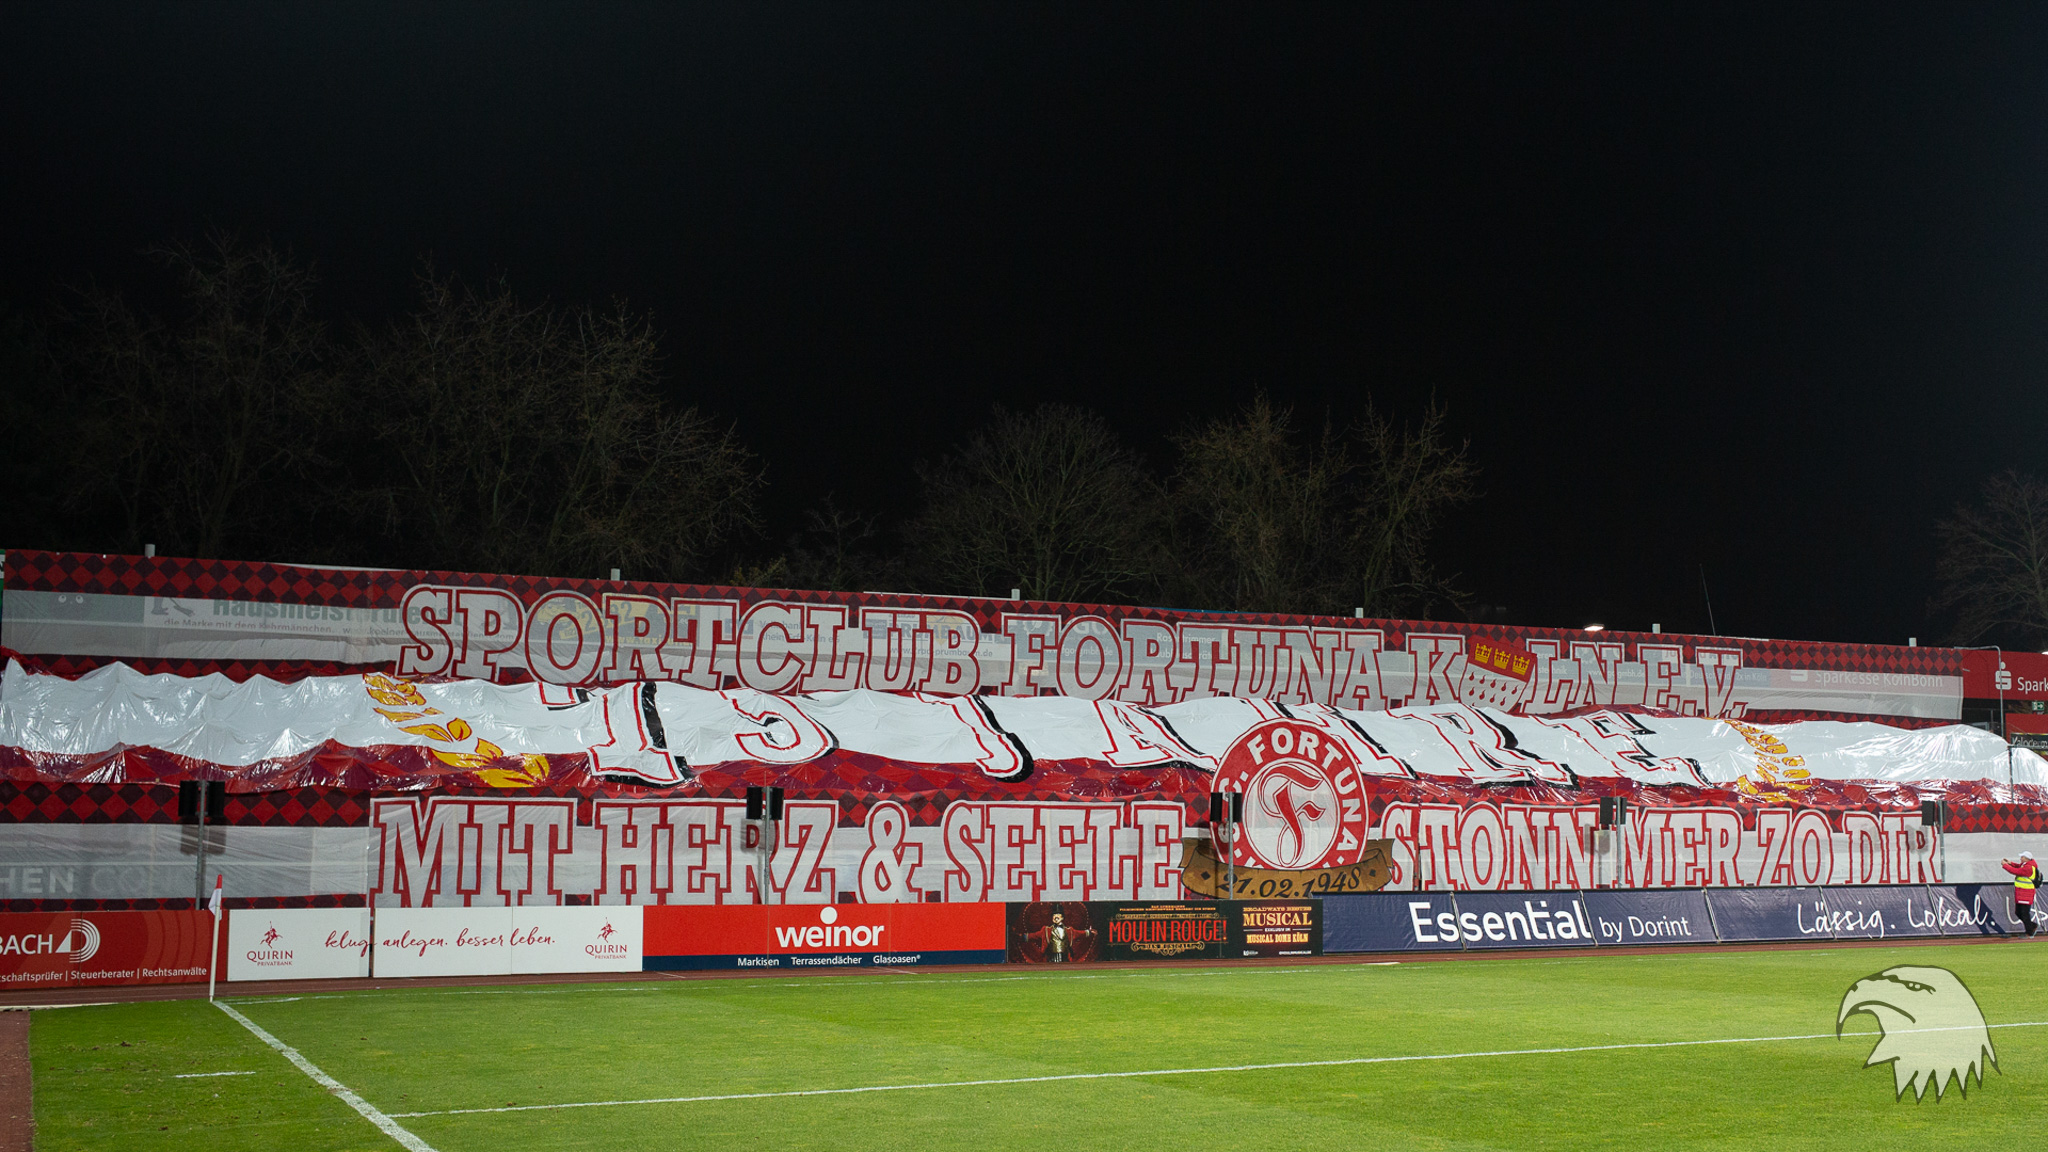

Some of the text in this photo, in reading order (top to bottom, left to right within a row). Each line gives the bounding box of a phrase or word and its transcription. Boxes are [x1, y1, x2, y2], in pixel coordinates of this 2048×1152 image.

[182, 619, 213, 627] Marke
[215, 621, 232, 629] mit
[234, 621, 257, 629] dem
[397, 584, 981, 694] SPORTCLUB
[1001, 612, 1384, 711] FORTUNA
[1814, 671, 1880, 686] Sparkasse
[1246, 727, 1362, 851] FORTUNA
[370, 796, 1943, 908] MIT HERZ & SEELE STONN MER ZO DIR
[1216, 866, 1362, 899] 21.02.1948
[775, 906, 885, 948] weinor
[1243, 912, 1312, 927] MUSICAL
[1408, 899, 1692, 943] Essential by Dorint
[1797, 901, 1896, 939] Lässig.
[1907, 894, 1996, 928] Lokal.
[382, 930, 448, 957] anlegen.
[456, 928, 504, 947] besser
[509, 926, 556, 947] leben.
[1109, 919, 1228, 943] MOULIN ROUGE!
[1246, 931, 1309, 944] MUSICAL DOME KÖLN
[0, 934, 53, 955] ACH
[584, 944, 628, 956] QUIRIN
[247, 950, 293, 962] QUIRIN
[737, 956, 780, 966] Markisen
[790, 955, 863, 966] Terrassendächer
[70, 969, 135, 980] Steuerberater
[142, 966, 207, 978] Rechtsanwälte
